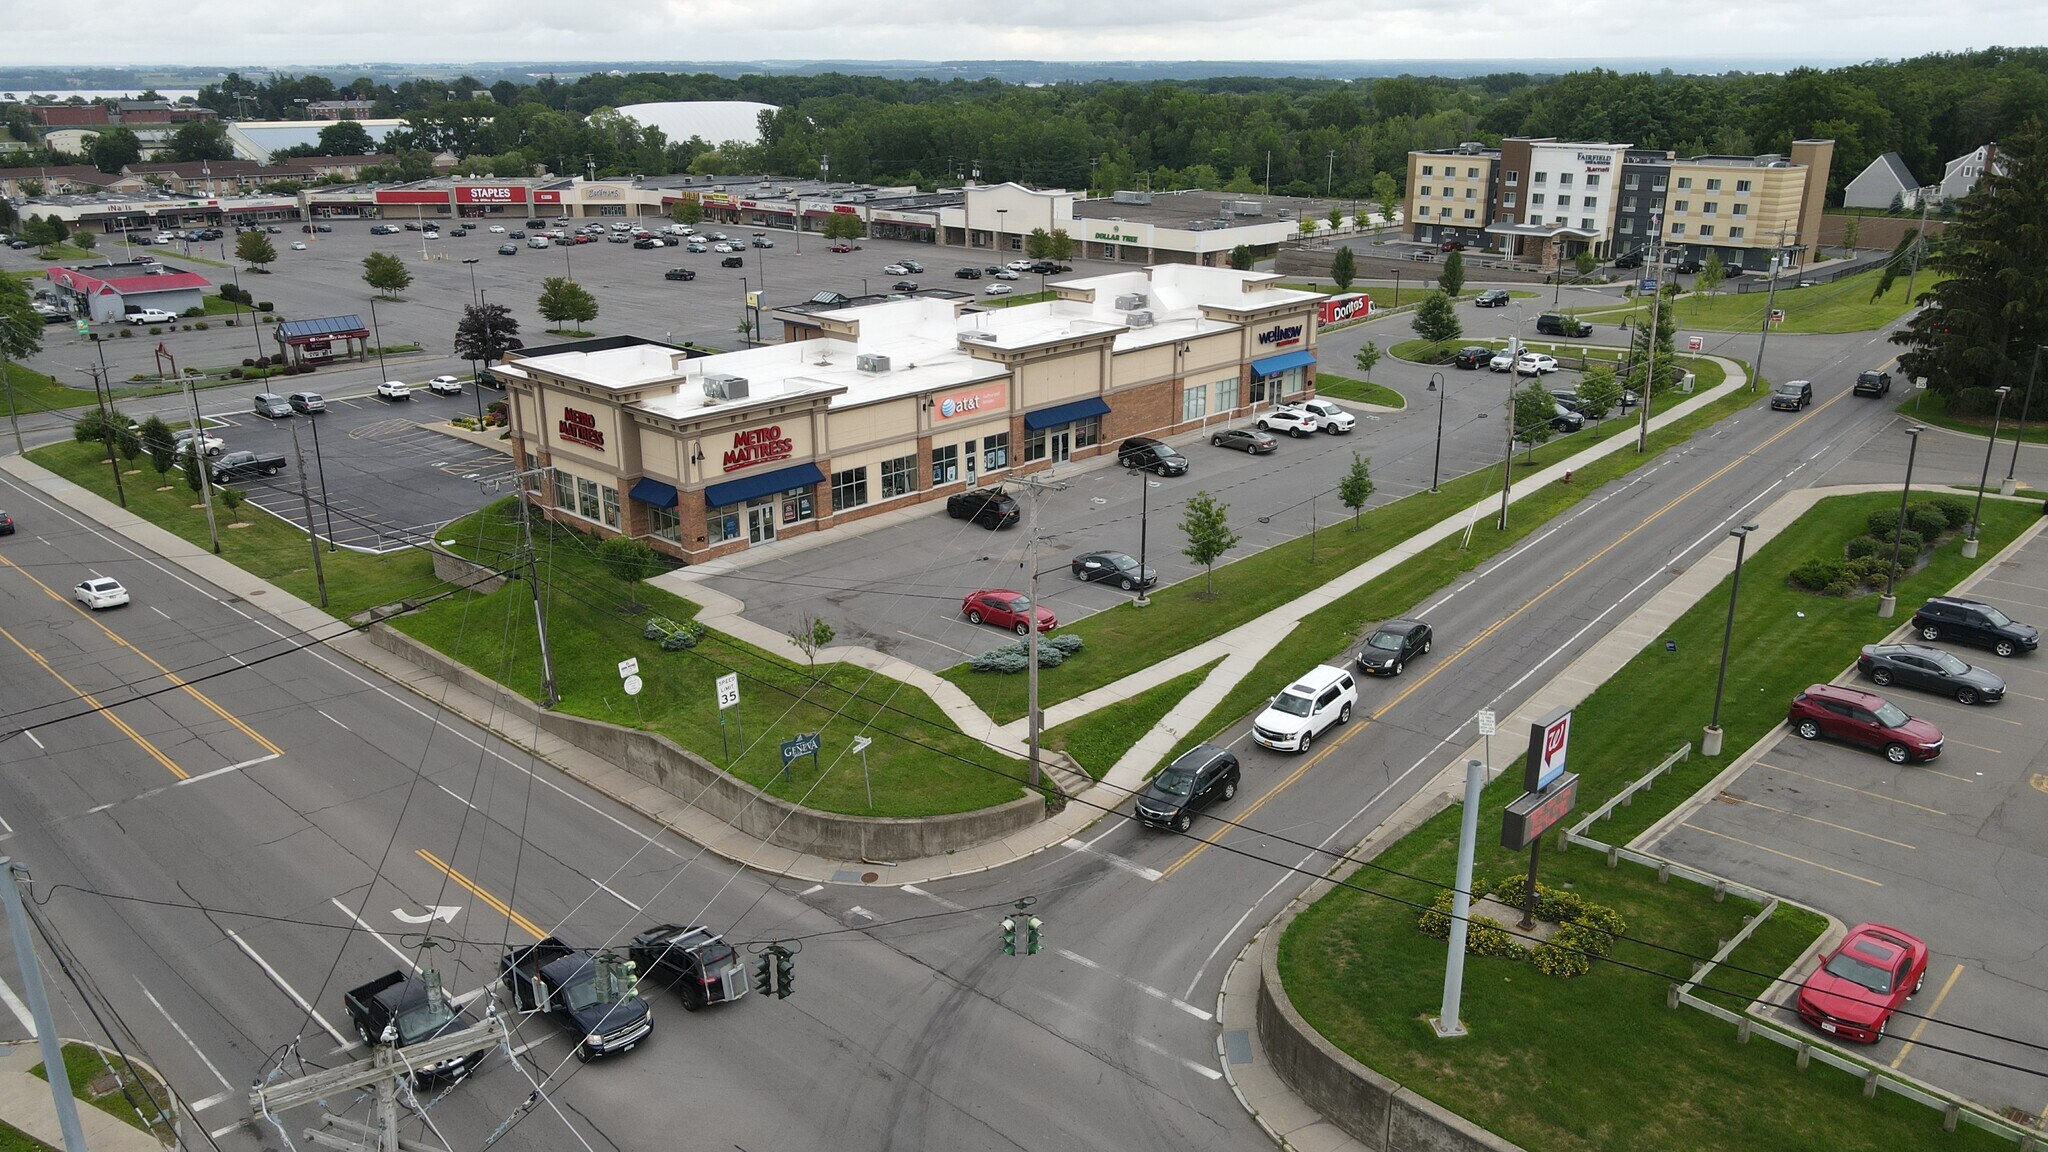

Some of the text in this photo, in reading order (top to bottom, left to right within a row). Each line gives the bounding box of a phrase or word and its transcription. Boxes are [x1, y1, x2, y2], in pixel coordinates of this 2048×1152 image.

[1577, 152, 1611, 160] FAIRFIELD
[471, 188, 511, 198] STAPLES
[833, 205, 856, 214] CINEMA
[1095, 233, 1138, 243] DOLLAR TREE
[1334, 297, 1364, 321] Doritos
[955, 394, 980, 413] at&t
[564, 406, 596, 429] METRO
[559, 420, 605, 446] MATTRESS
[734, 425, 781, 449] METRO
[723, 438, 793, 466] MATTRESS
[718, 676, 735, 687] SPEED
[720, 684, 734, 693] LIMIT
[721, 690, 737, 705] 35
[784, 740, 818, 757] GENEVA
